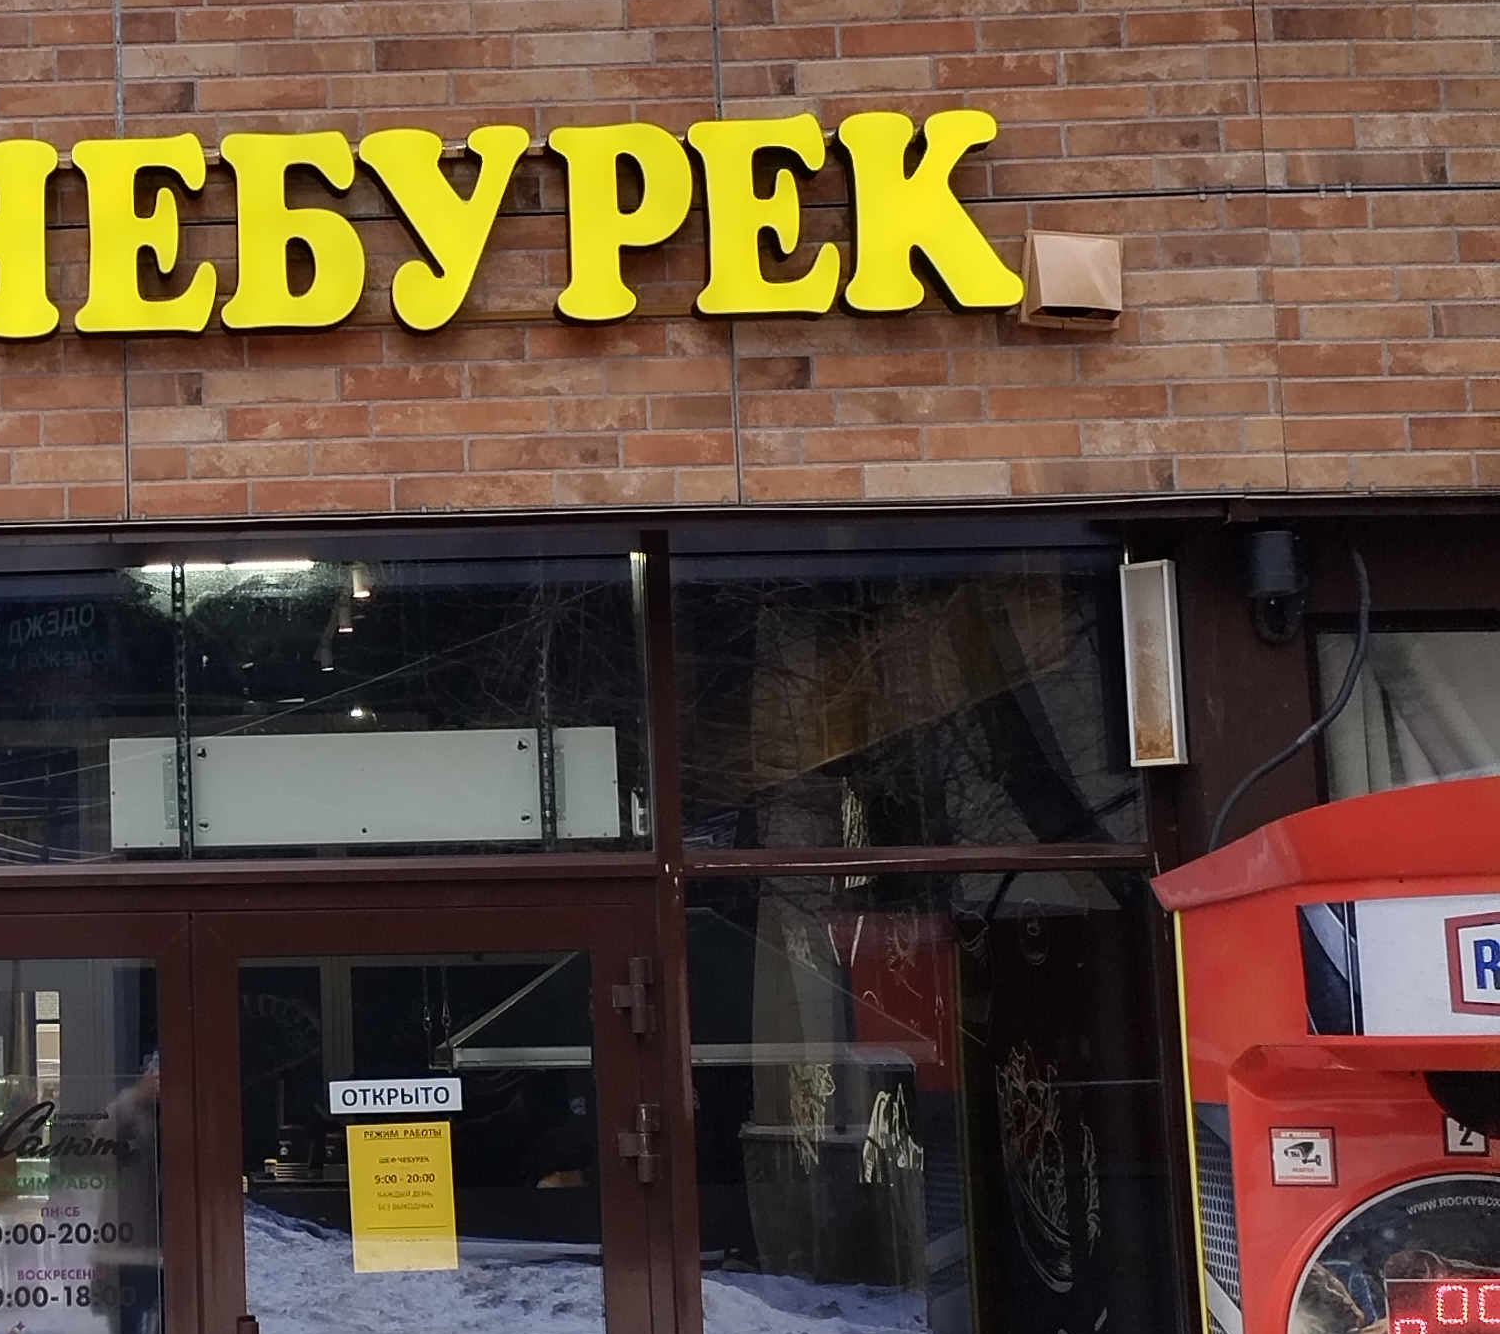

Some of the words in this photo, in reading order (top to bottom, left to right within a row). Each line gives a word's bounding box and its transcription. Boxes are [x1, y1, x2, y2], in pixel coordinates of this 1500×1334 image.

[341, 1086, 450, 1107] ОТКРЫТО
[404, 1129, 441, 1137] РАБОТЫ
[406, 1173, 436, 1184] 20:00
[40, 1206, 81, 1218] ПН-СБ
